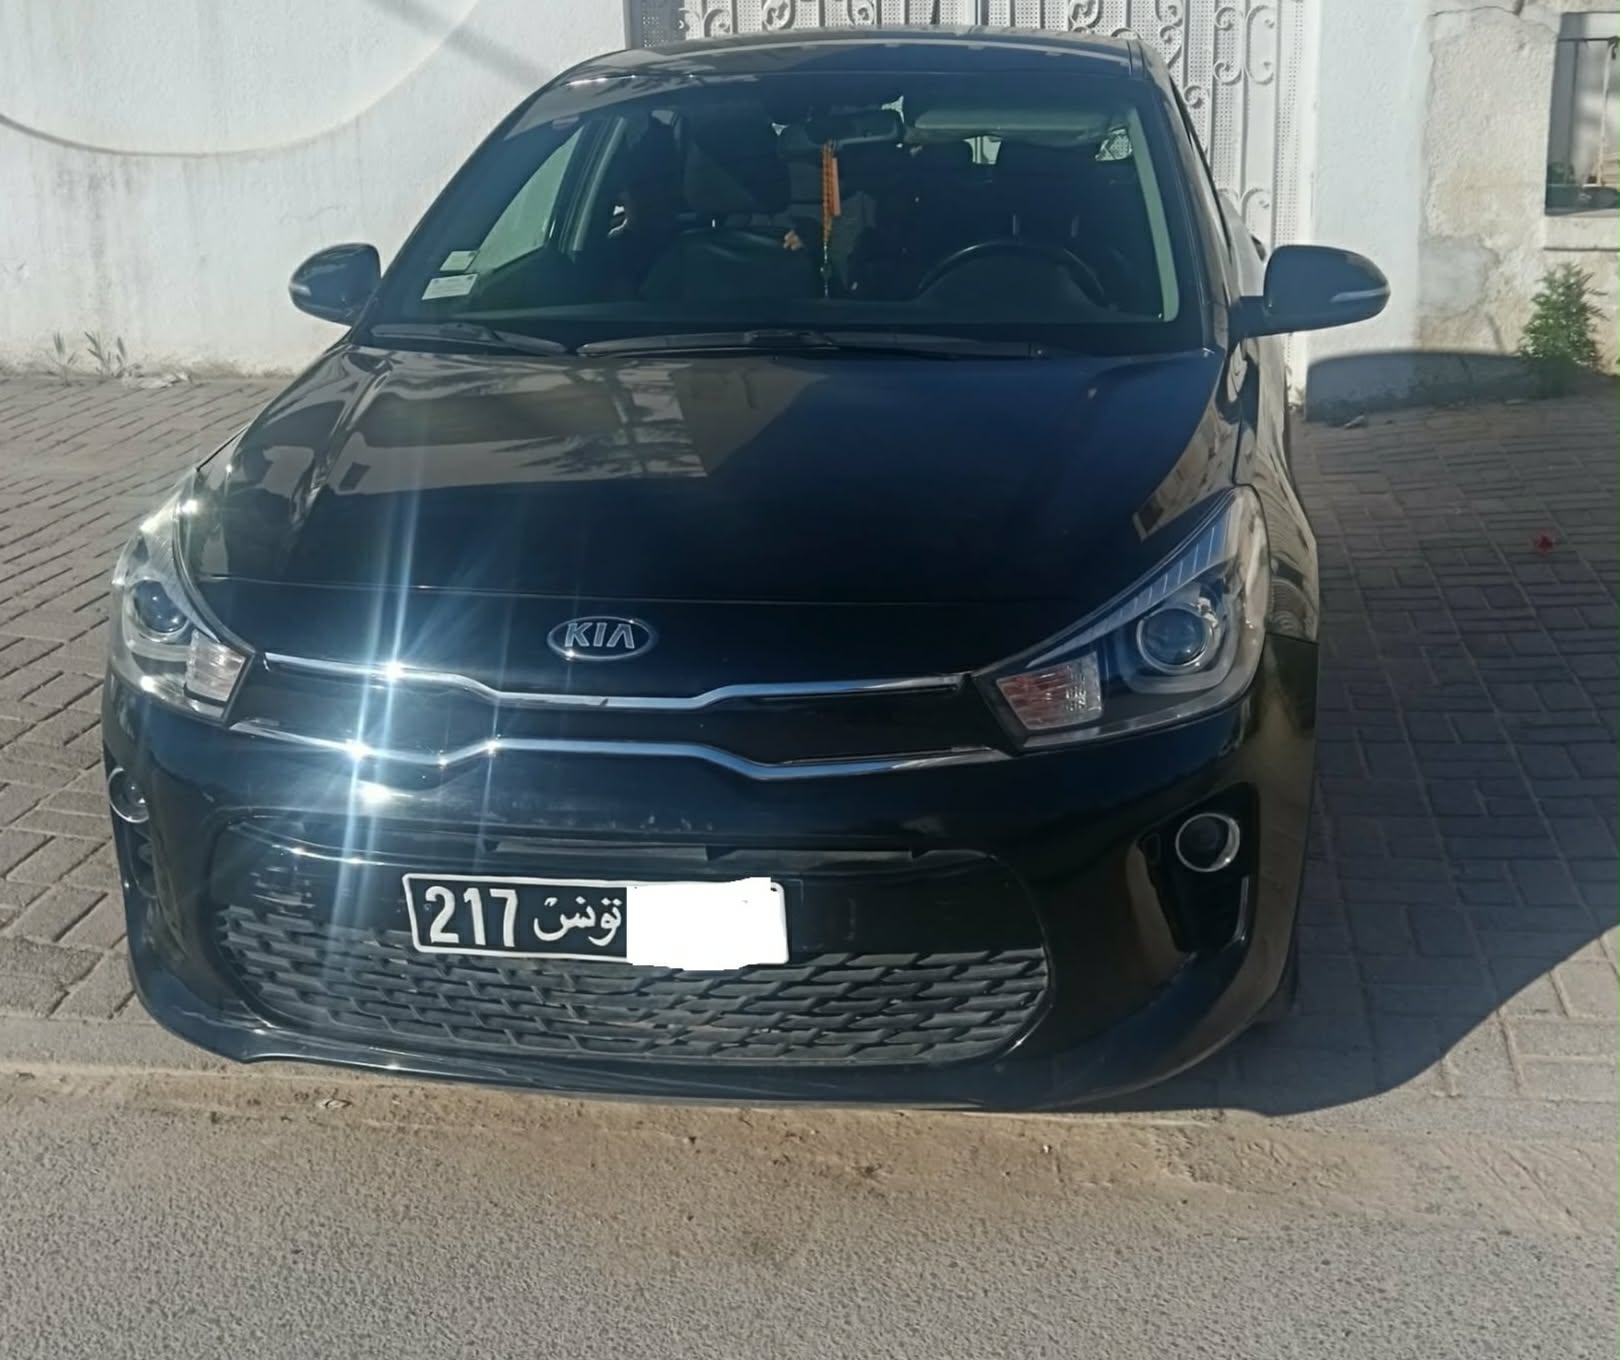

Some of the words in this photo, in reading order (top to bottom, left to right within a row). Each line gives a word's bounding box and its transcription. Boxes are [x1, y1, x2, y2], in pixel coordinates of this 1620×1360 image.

[564, 622, 635, 649] KIA
[424, 885, 518, 947] 217
[533, 896, 622, 946] تونس
